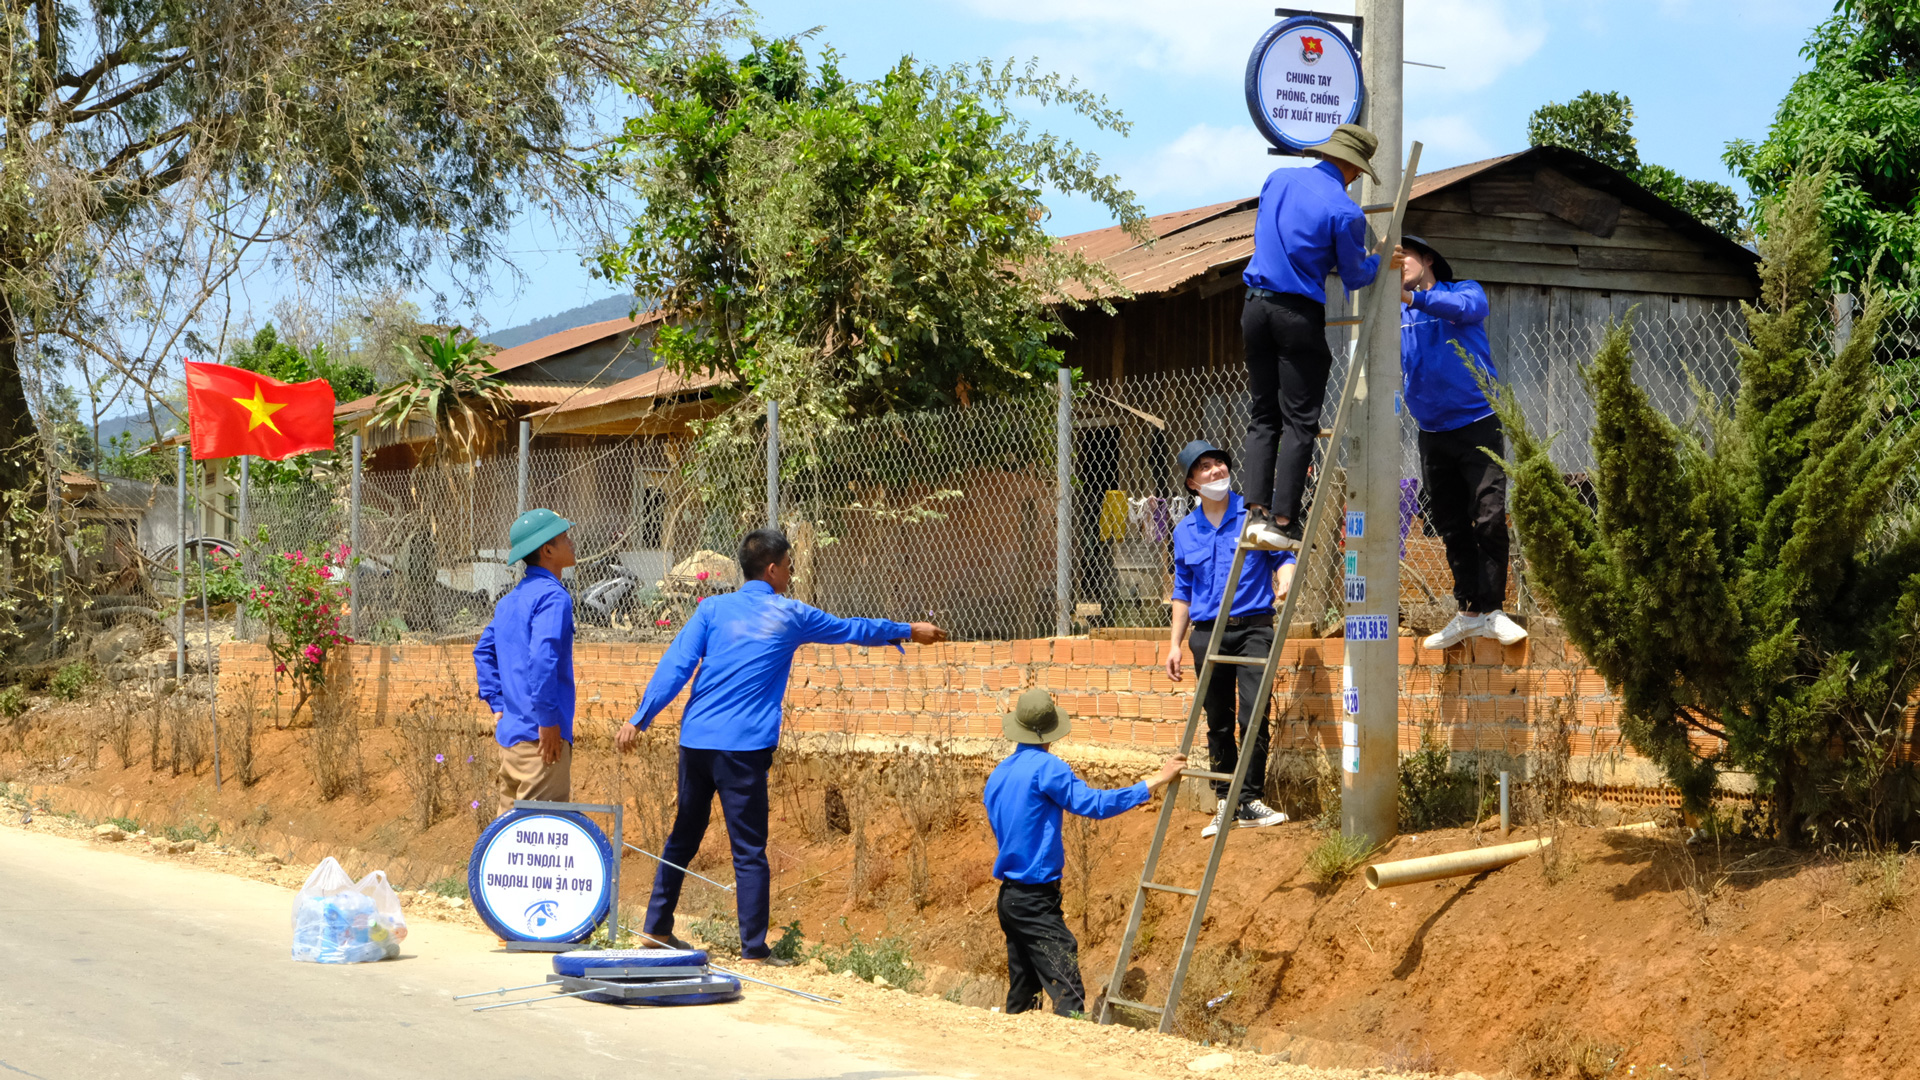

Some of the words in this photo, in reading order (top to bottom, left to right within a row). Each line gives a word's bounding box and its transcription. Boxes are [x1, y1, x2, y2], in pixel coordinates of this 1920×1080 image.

[1286, 71, 1315, 85] CHUNG
[1318, 75, 1332, 87] TAY
[1276, 87, 1308, 104] PHÒNG,
[1310, 90, 1340, 106] CHỐNG
[1272, 104, 1289, 119] SỐT
[1291, 107, 1313, 122] XUẤT
[1315, 110, 1342, 125] HUYẾT
[516, 830, 544, 847] VỮNG
[507, 852, 523, 865] LAI
[526, 854, 561, 868] TƯƠNG
[564, 855, 574, 871] VÌ
[487, 873, 529, 890] TRƯỜNG
[532, 876, 552, 891] MÔI
[555, 874, 568, 892] VỆ
[571, 878, 593, 896] BẢO
